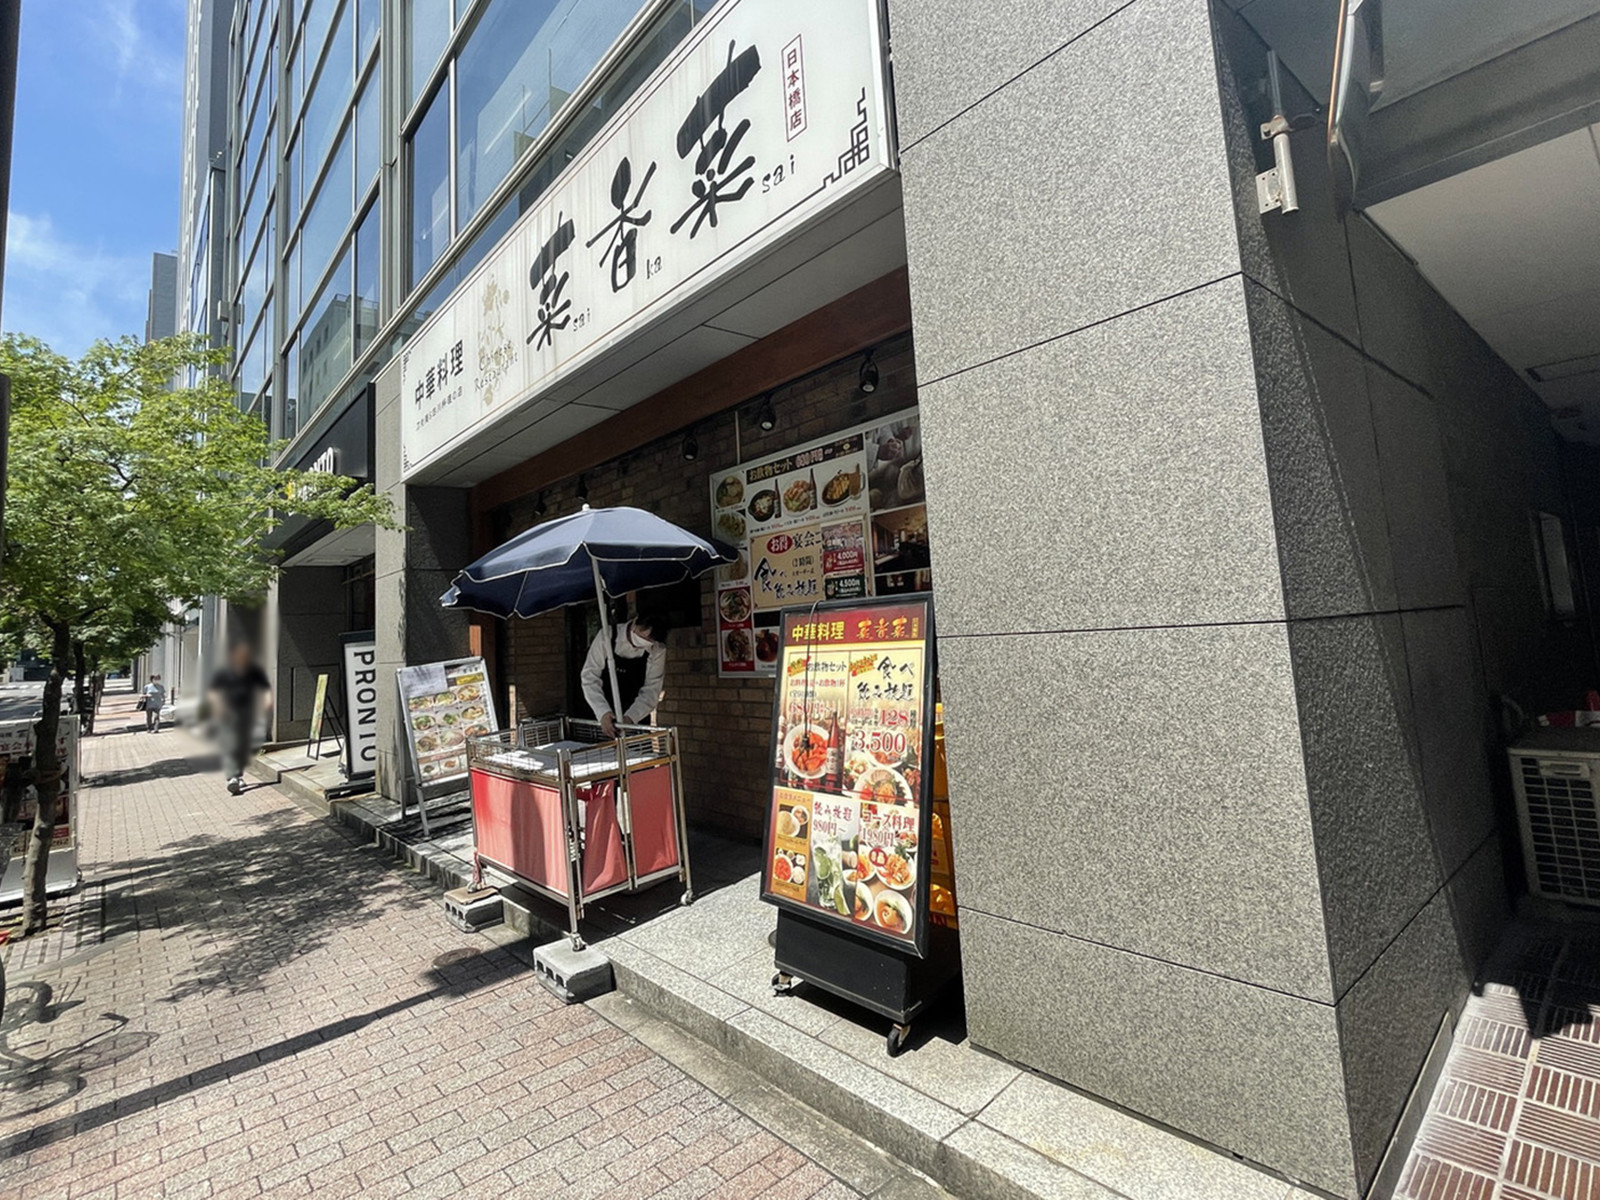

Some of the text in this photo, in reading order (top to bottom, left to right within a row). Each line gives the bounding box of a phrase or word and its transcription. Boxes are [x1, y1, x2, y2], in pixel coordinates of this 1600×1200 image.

[786, 46, 803, 130] 日本橋店
[761, 154, 797, 194] sai
[525, 39, 762, 352] 菜香菜
[645, 255, 663, 281] ka
[571, 306, 592, 334] sai
[414, 338, 465, 410] 中華料理
[791, 621, 845, 642] 中華料理
[880, 708, 910, 728] 128
[861, 811, 916, 834] コース料理
